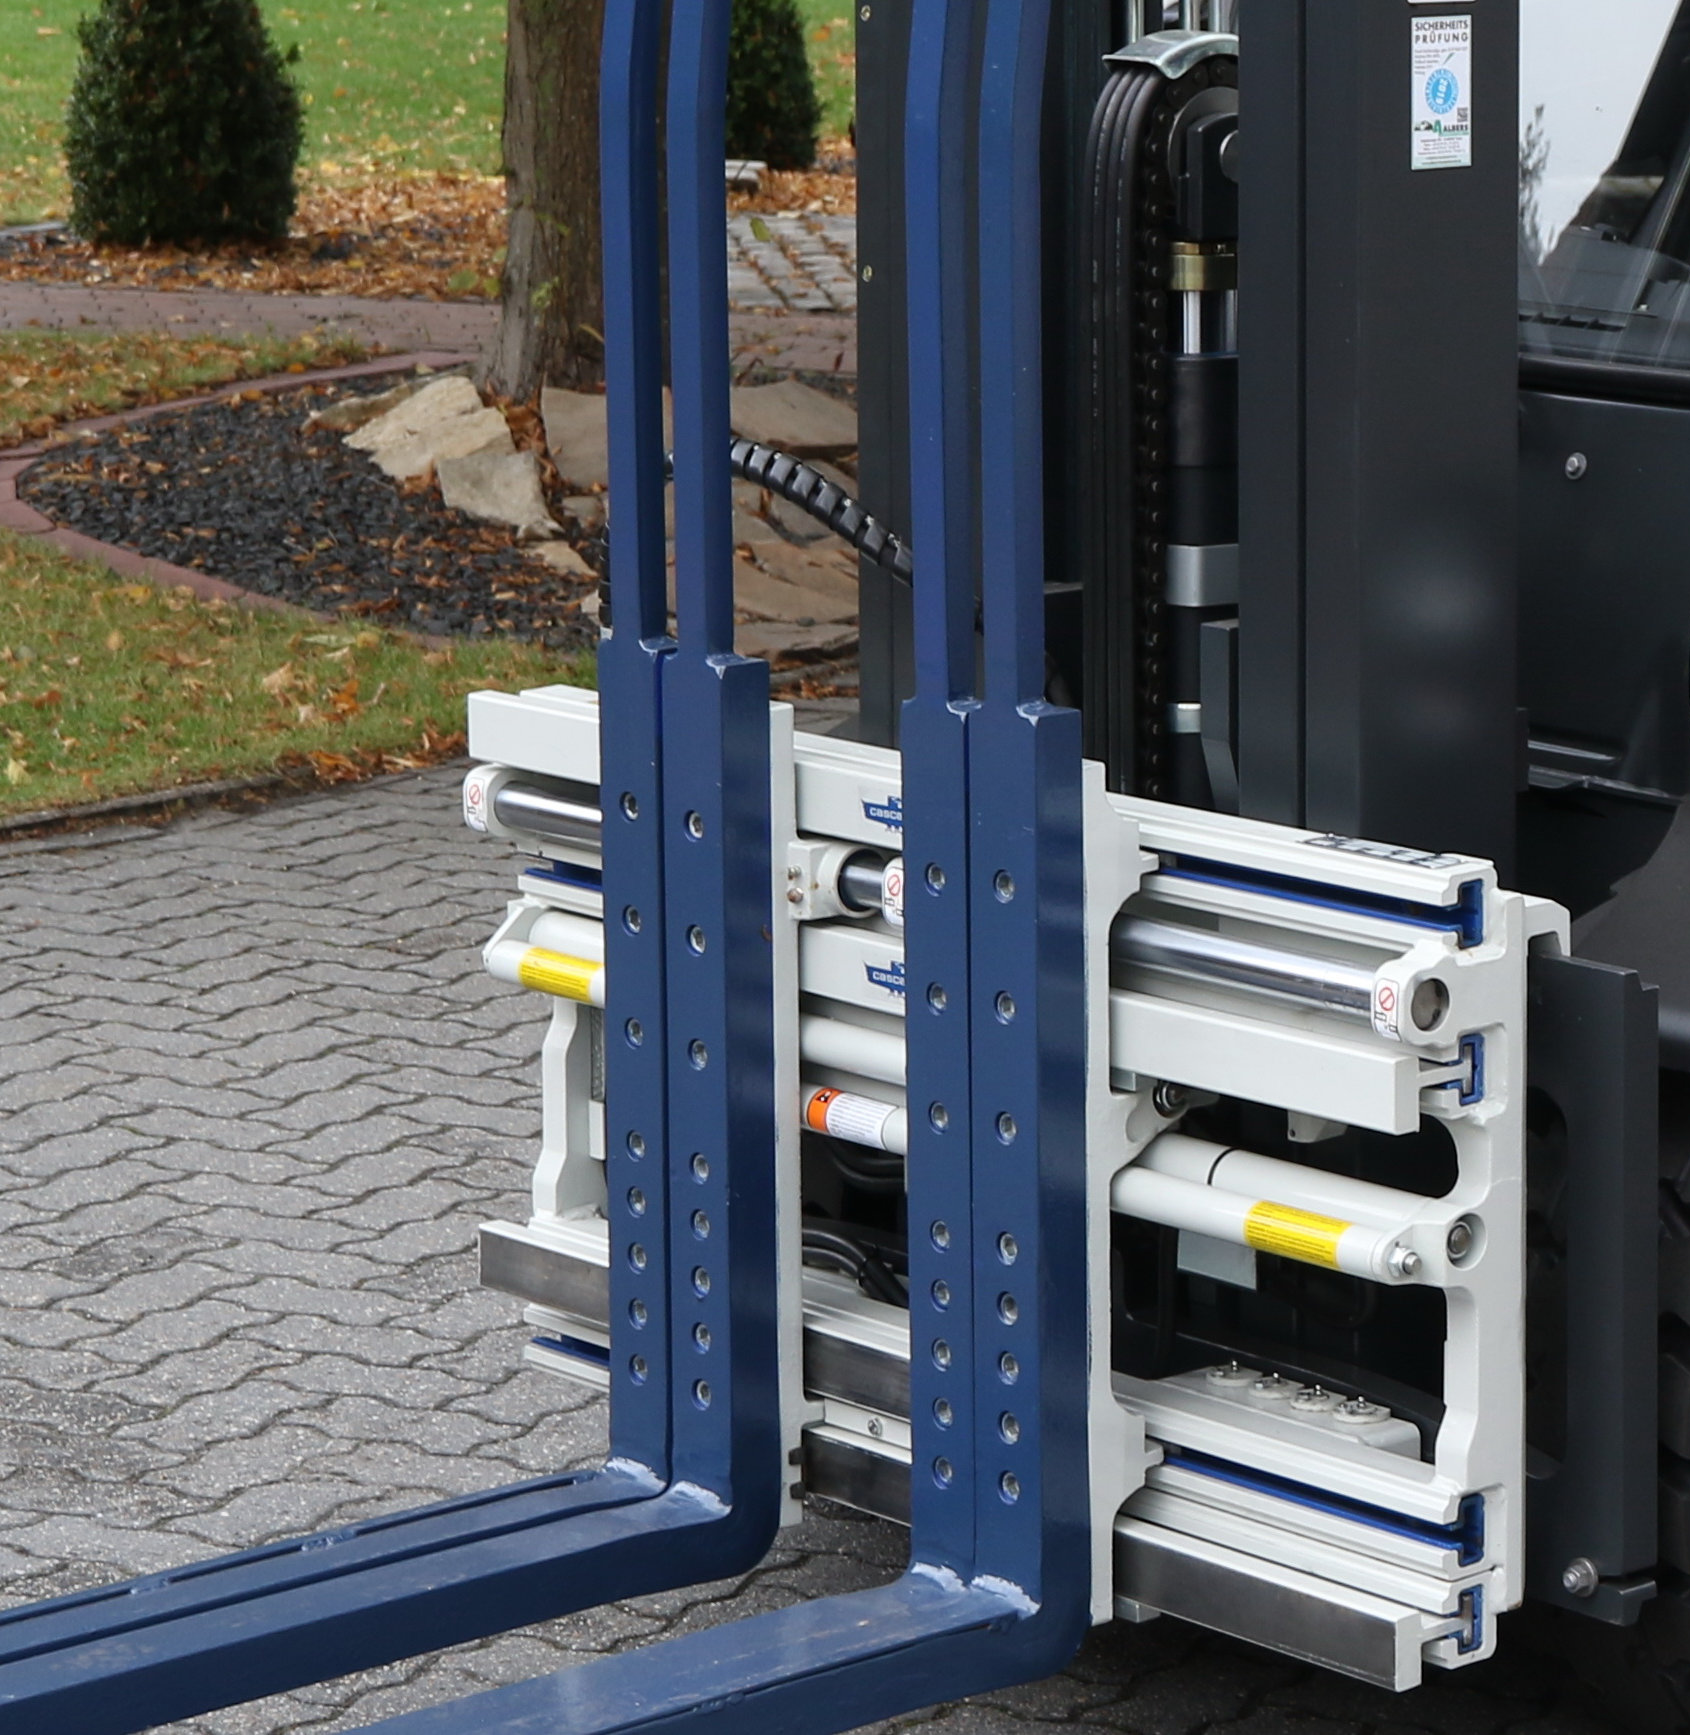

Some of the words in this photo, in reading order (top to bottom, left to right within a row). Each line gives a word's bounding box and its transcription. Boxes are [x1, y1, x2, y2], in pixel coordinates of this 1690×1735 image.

[1415, 19, 1468, 32] SICHERHEITS
[1415, 30, 1469, 44] PRÜFUNG
[1443, 123, 1469, 133] ALBERS
